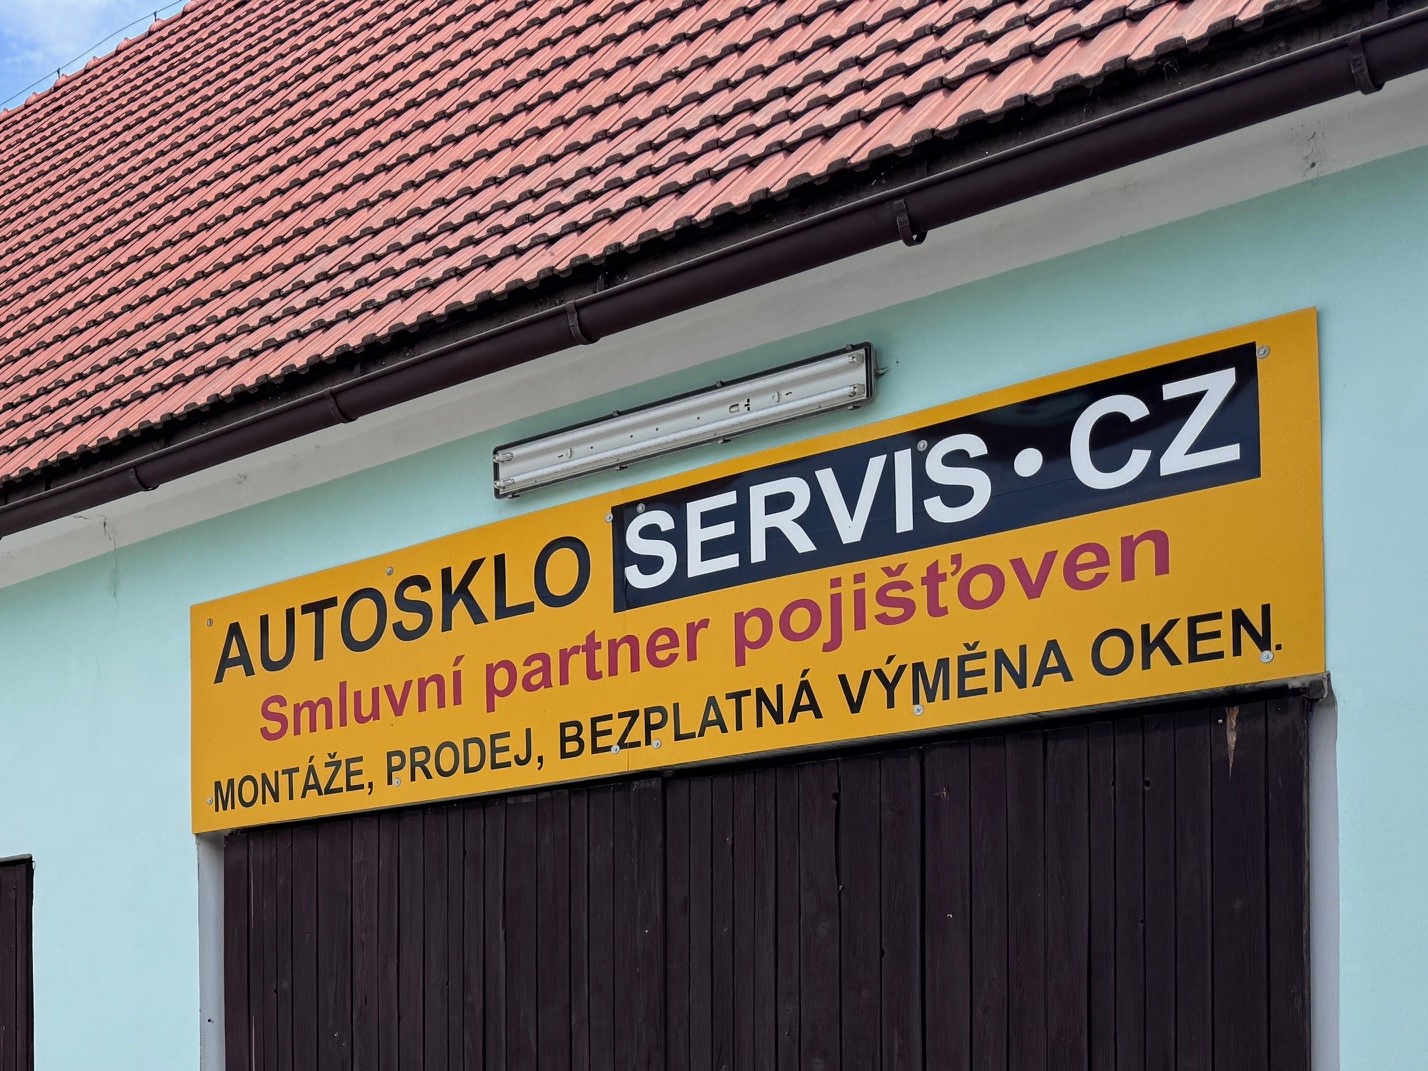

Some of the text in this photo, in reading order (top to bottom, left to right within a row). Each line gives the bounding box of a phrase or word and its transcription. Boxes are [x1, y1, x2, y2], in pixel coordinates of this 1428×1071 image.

[214, 537, 591, 683] AUTOSKLO
[214, 603, 1282, 812] MONTÁŽE, PRODEJ, BEZPLATNÁ VÝMĚNA OKEN.
[260, 528, 1170, 741] Smluvní partner pojišťoven
